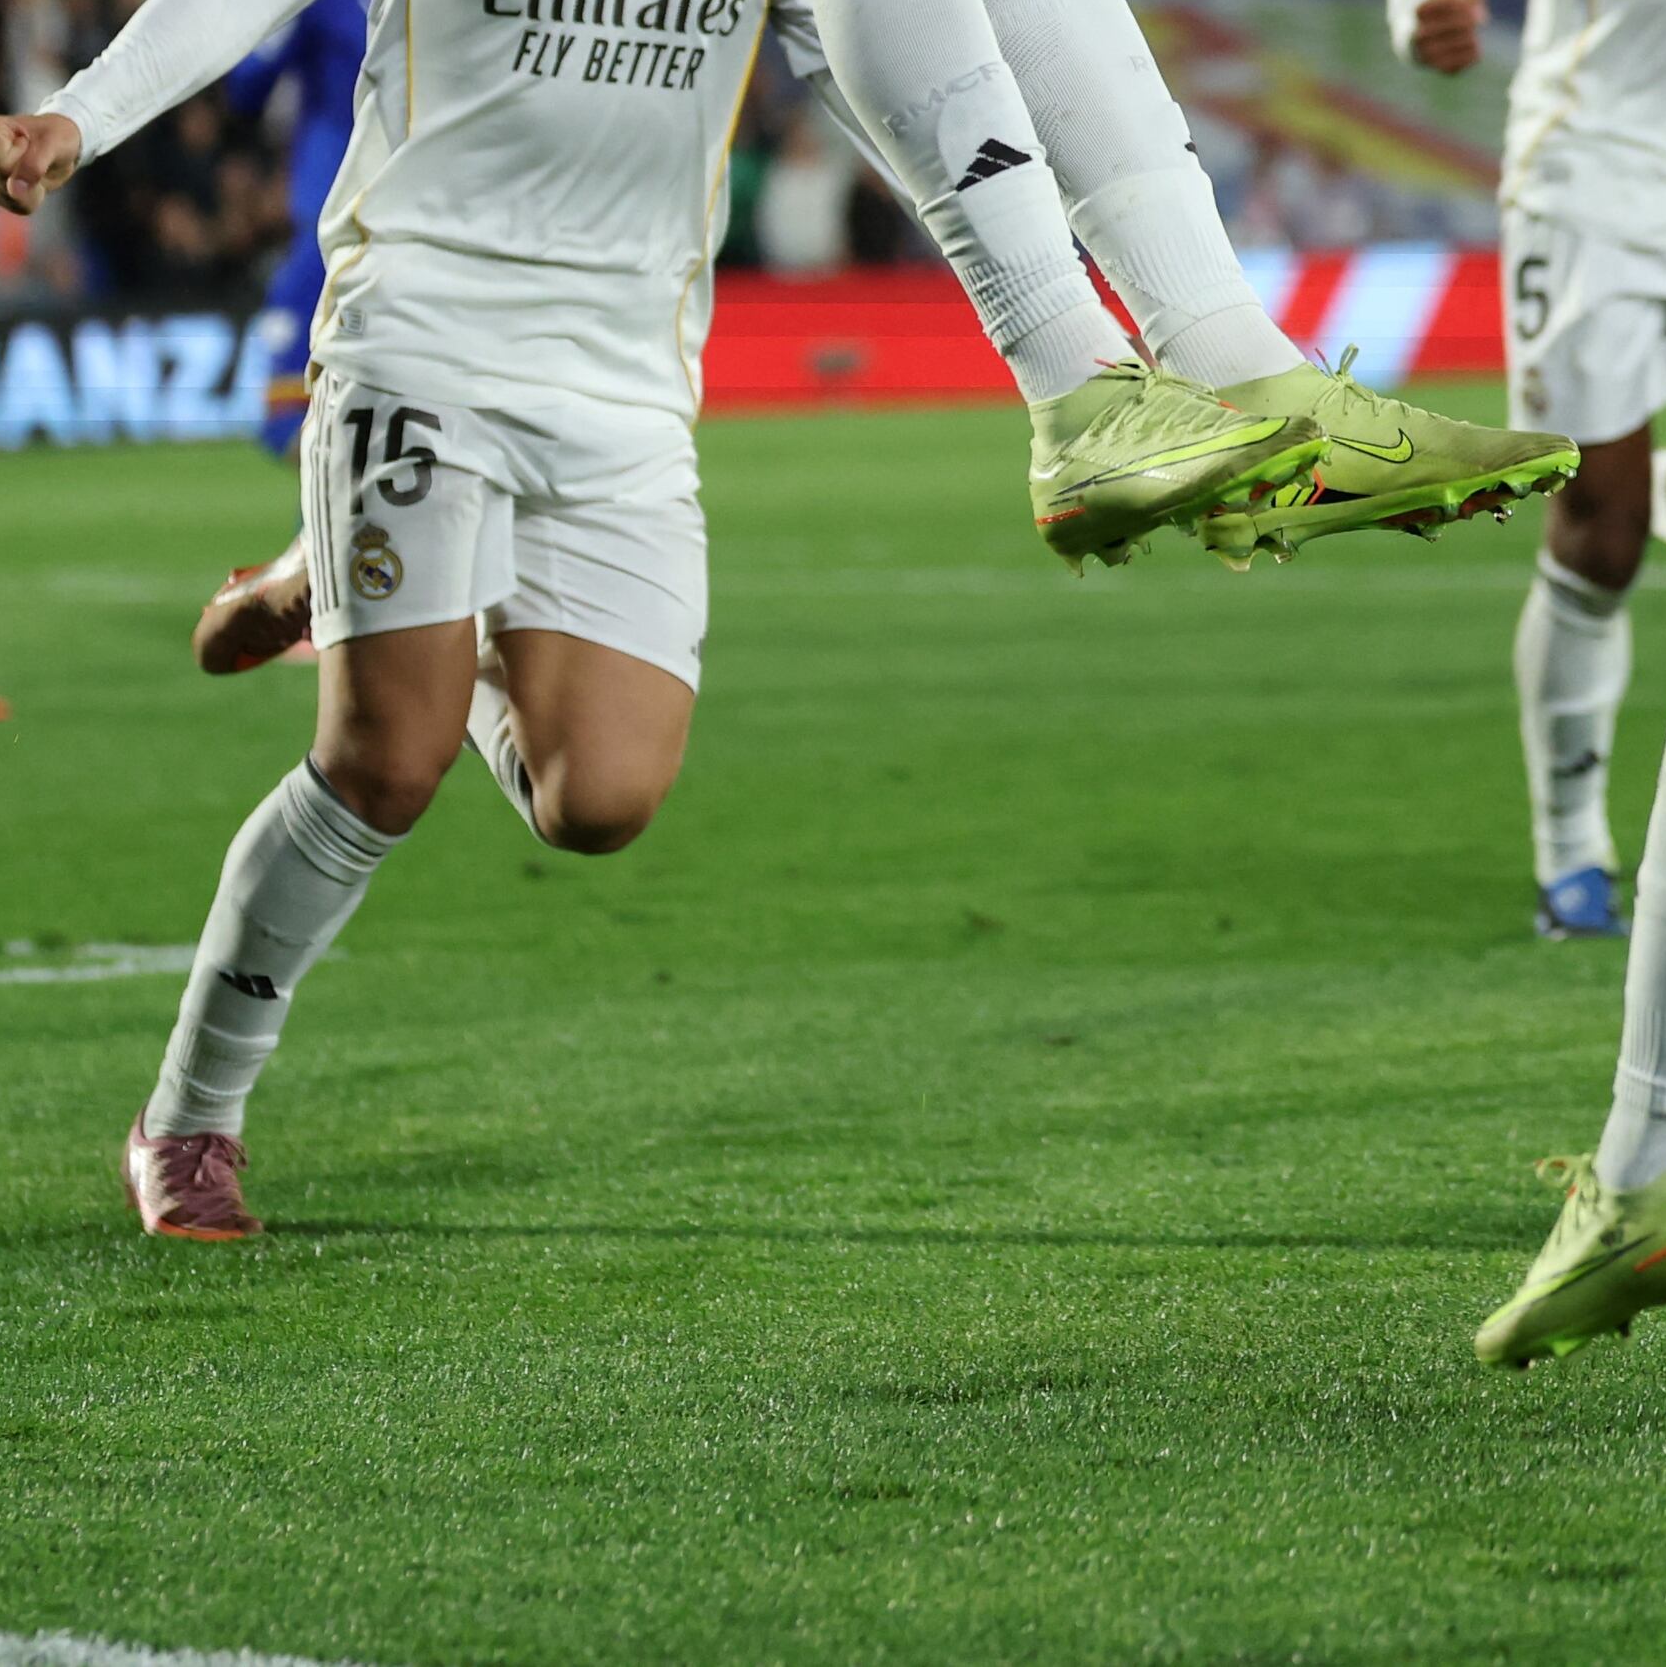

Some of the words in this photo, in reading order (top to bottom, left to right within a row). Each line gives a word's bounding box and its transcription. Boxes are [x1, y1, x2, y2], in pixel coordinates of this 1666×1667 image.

[512, 30, 576, 78] FLY
[583, 37, 706, 91] BETTER
[1516, 257, 1550, 342] 5
[344, 406, 442, 515] 15
